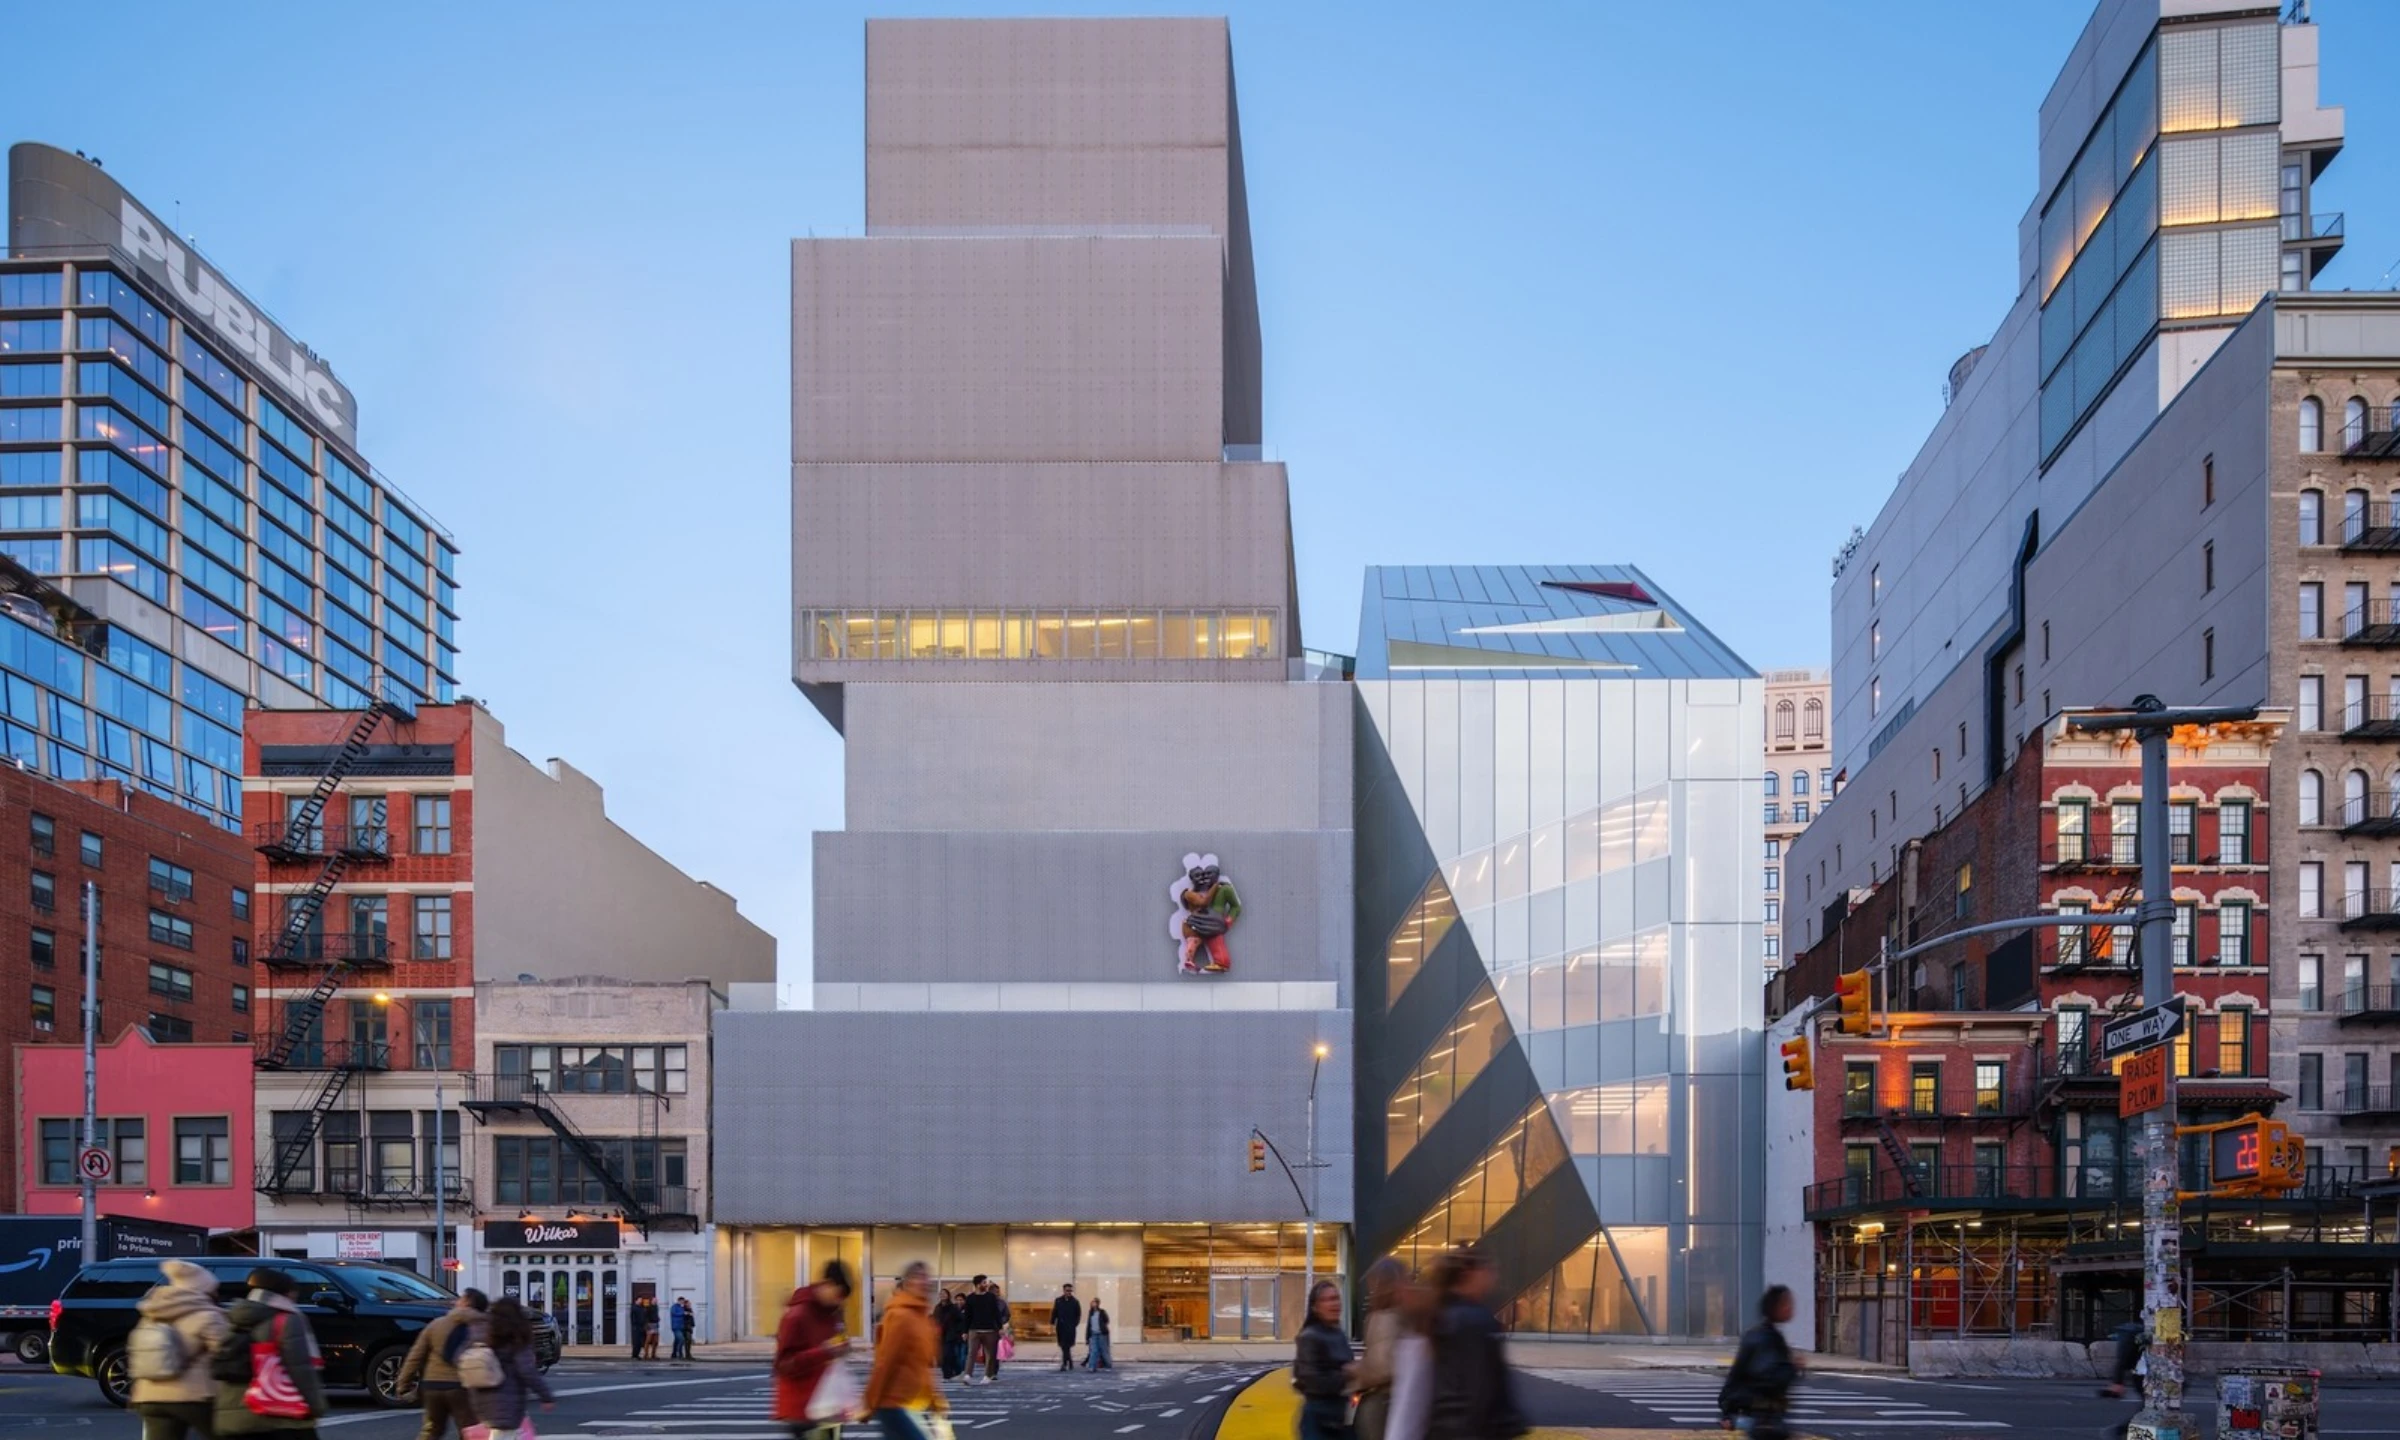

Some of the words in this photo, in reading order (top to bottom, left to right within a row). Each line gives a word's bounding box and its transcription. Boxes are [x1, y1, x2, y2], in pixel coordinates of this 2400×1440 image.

[120, 197, 344, 428] PUBLIC
[2110, 1027, 2132, 1047] ONE
[2142, 1014, 2168, 1036] WAY
[2126, 1055, 2159, 1084] RAISE
[2126, 1082, 2158, 1110] PLOW
[117, 1232, 149, 1245] There's
[151, 1238, 173, 1247] more
[117, 1243, 128, 1251] to
[524, 1224, 579, 1244] Wilka's
